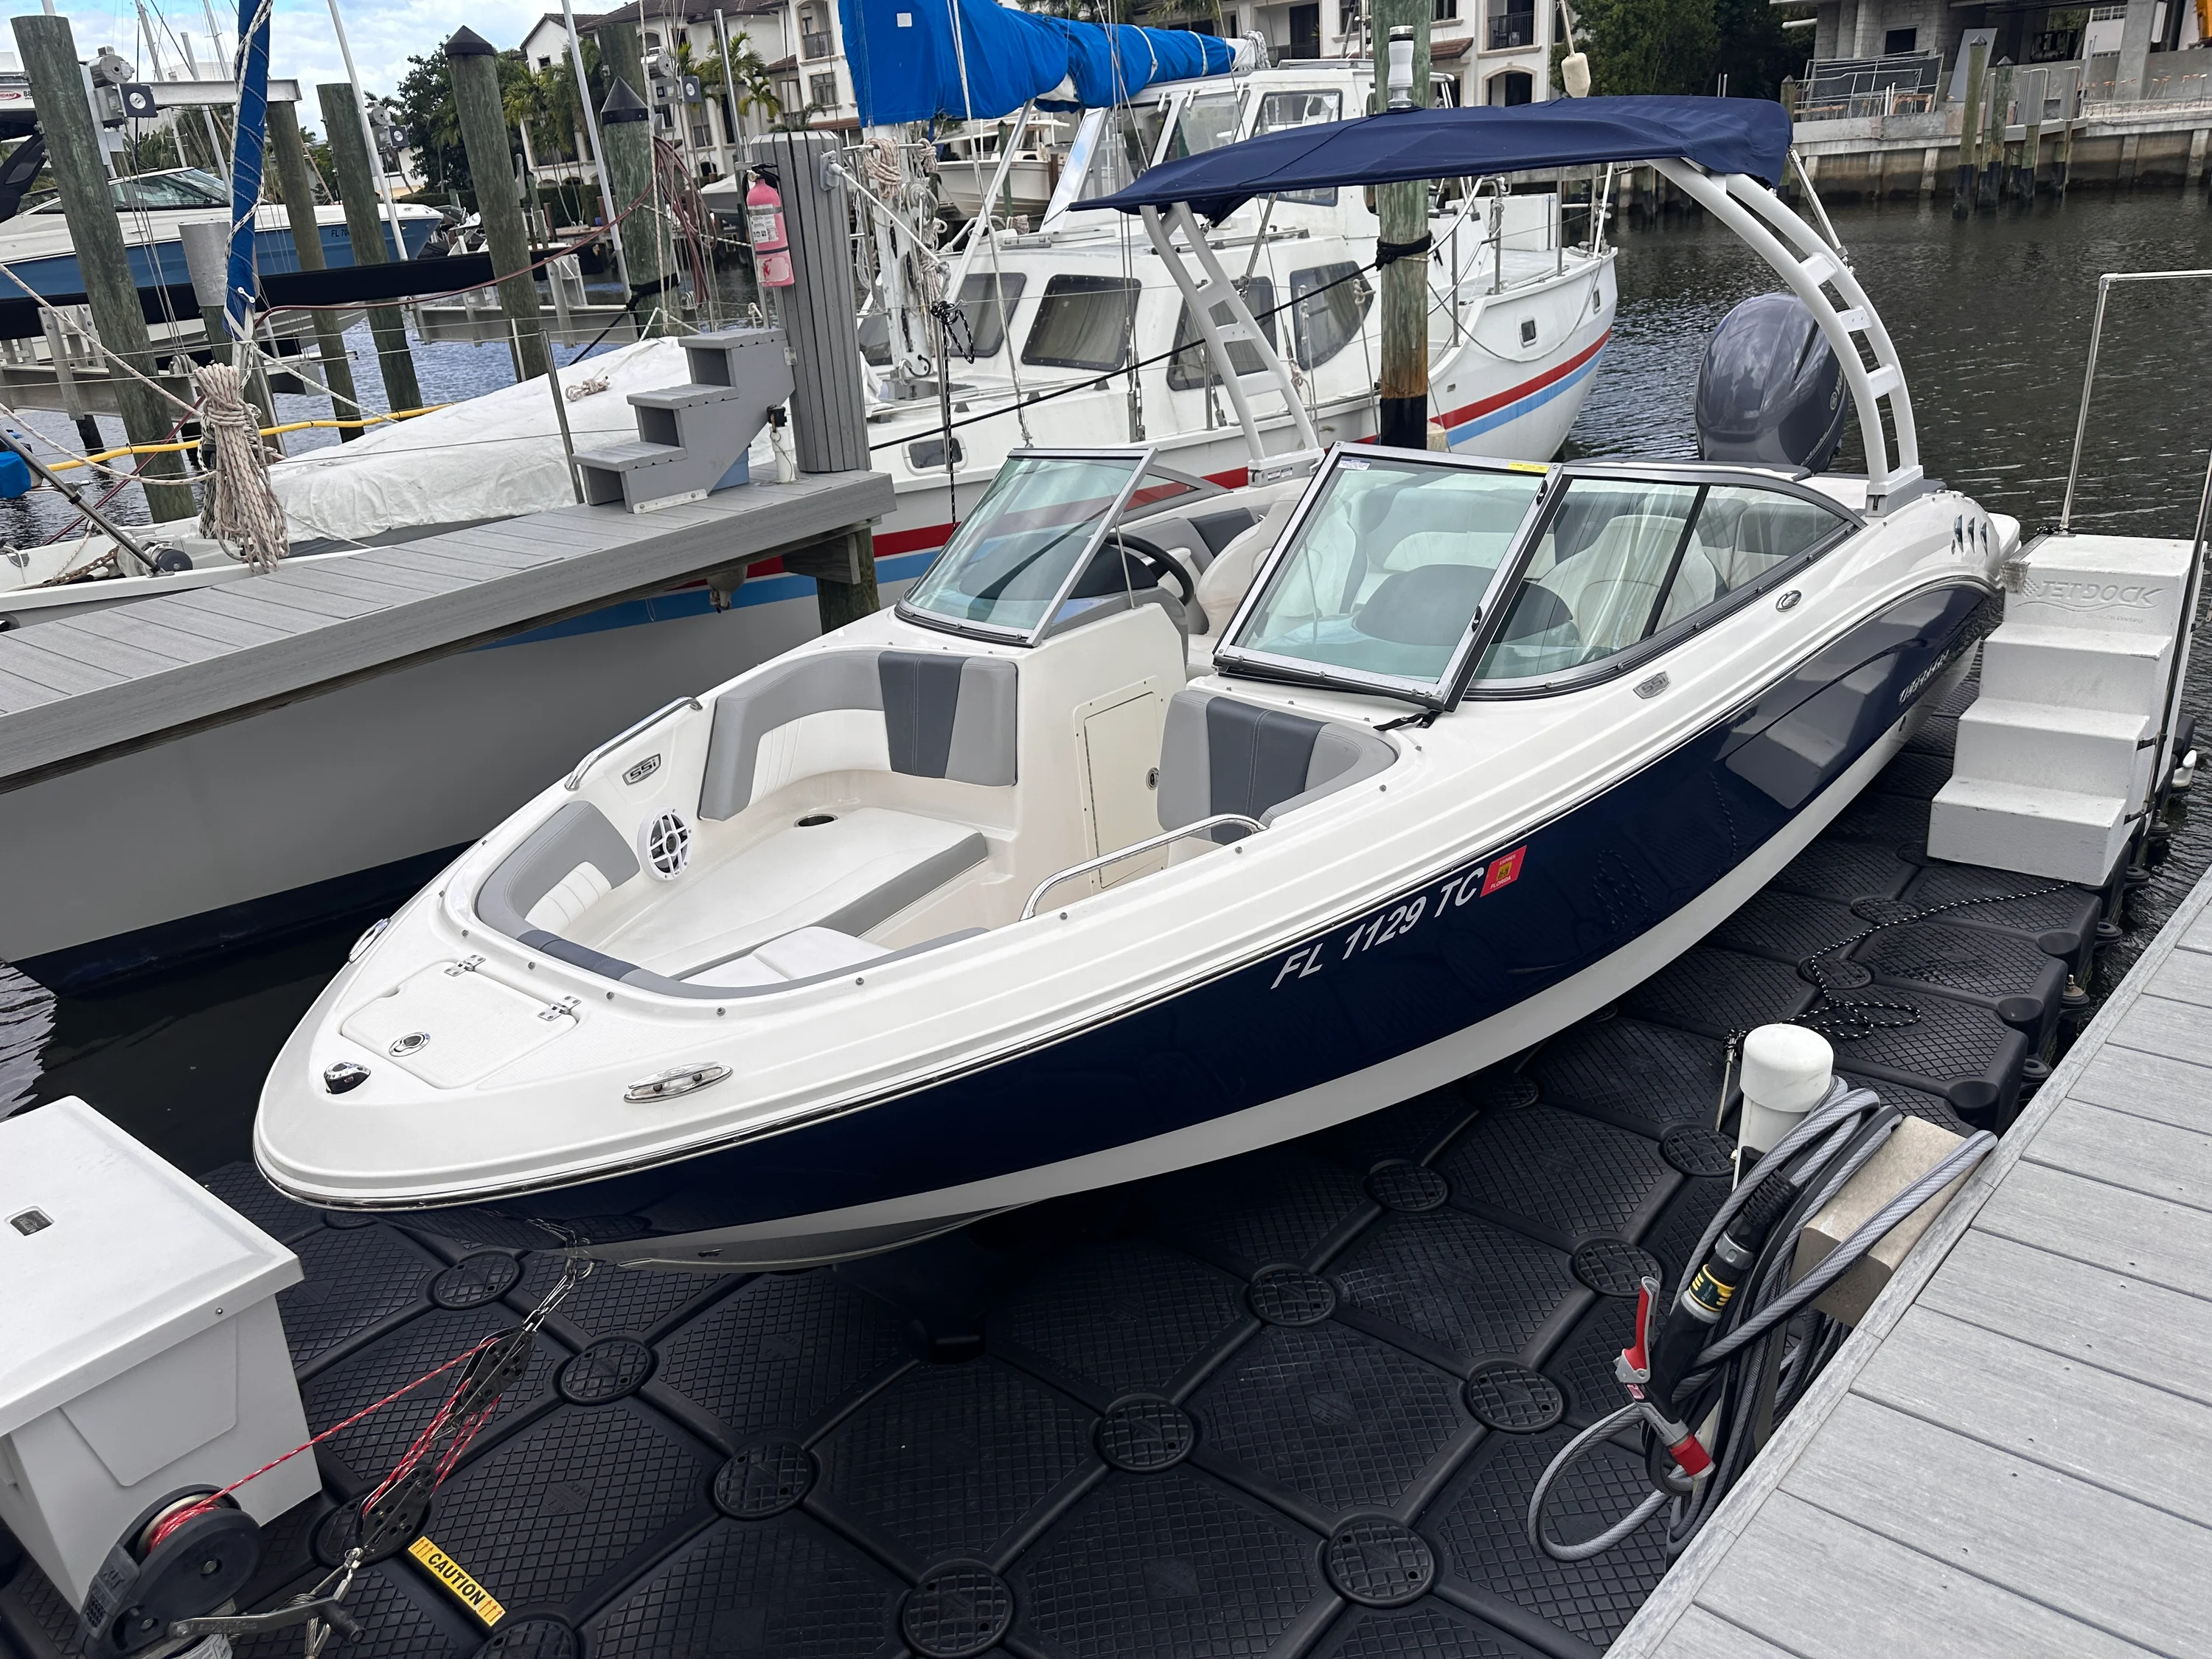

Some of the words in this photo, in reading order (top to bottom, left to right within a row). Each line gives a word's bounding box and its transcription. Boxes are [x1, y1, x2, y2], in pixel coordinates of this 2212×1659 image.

[331, 229, 339, 237] FL
[2036, 580, 2082, 600] JET
[2080, 583, 2165, 605] DOCK
[1490, 875, 1512, 889] FLORIDA
[1270, 942, 1324, 990] FL
[1342, 896, 1427, 960] 1129
[1434, 866, 1484, 918] TC
[428, 1553, 487, 1606] CAUTION
